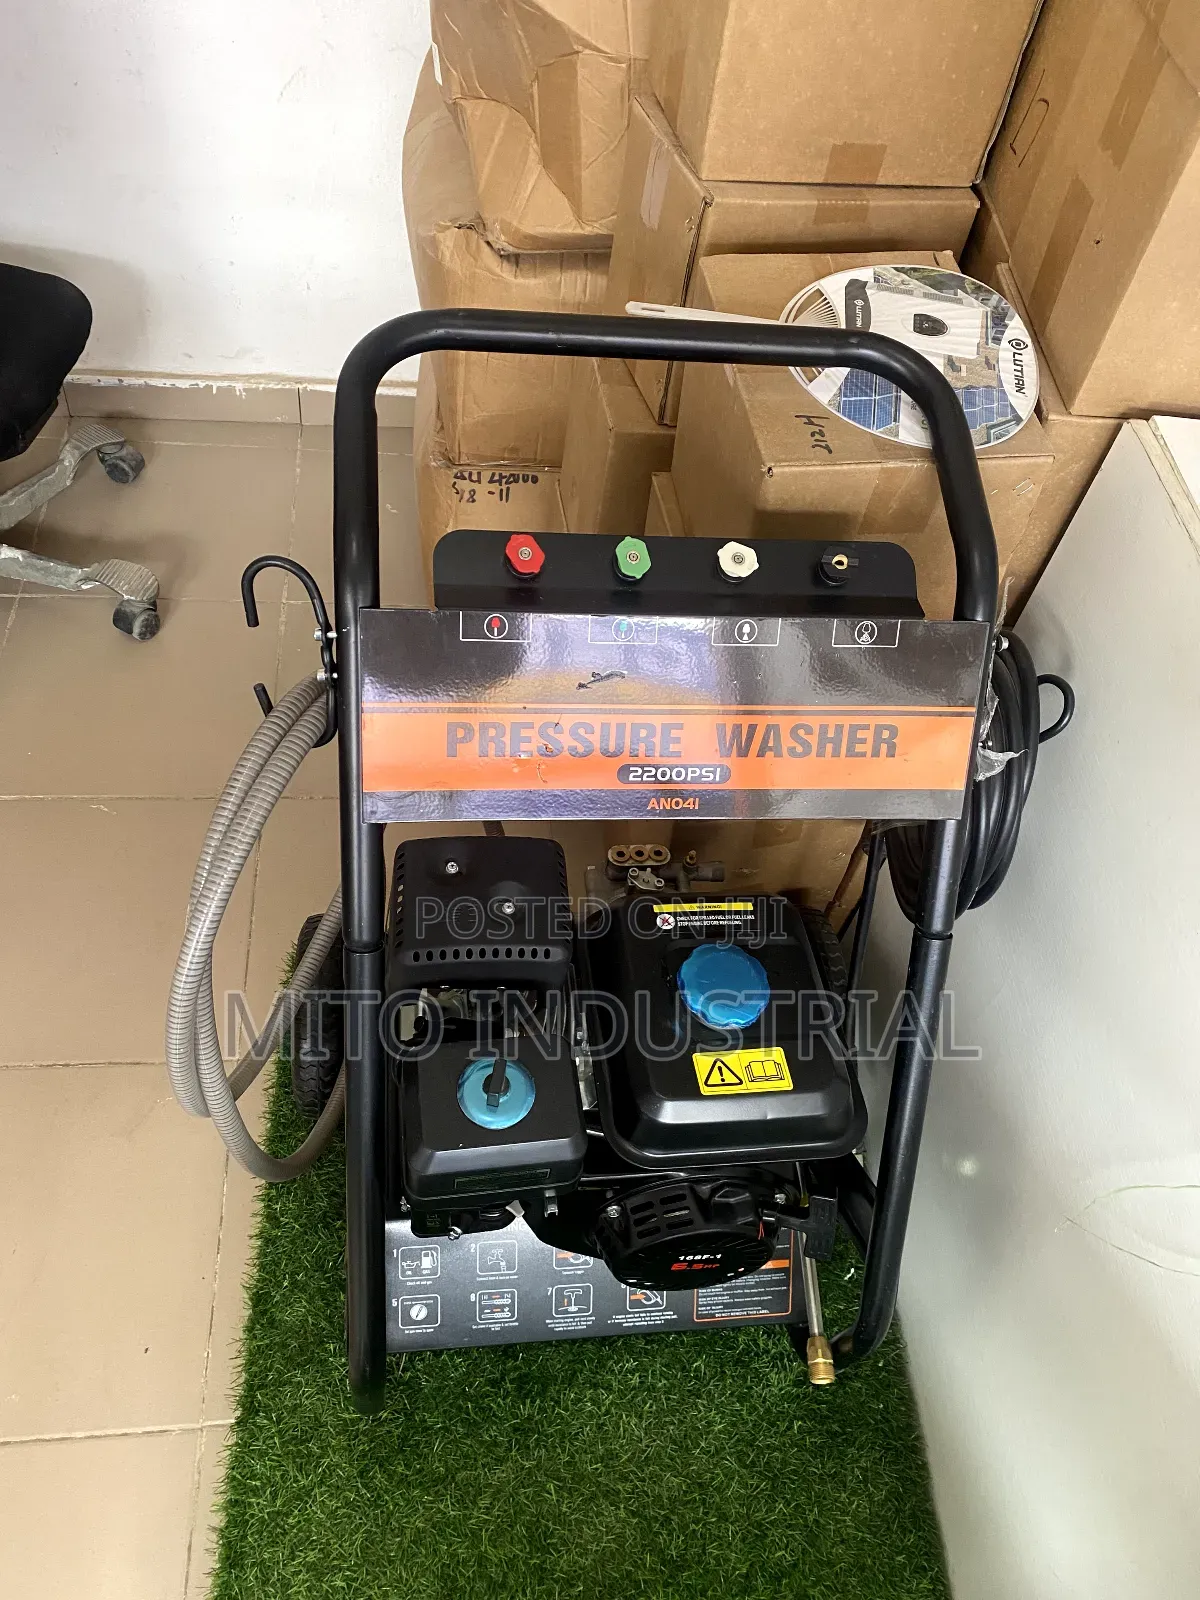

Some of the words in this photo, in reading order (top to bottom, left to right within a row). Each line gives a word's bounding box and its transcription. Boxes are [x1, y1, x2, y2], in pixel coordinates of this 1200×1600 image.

[1011, 350, 1026, 395] LUTIAN
[446, 721, 685, 758] PRESSURE
[715, 722, 899, 759] WASHER
[628, 766, 721, 782] 2200PSI
[547, 1287, 552, 1296] 7
[392, 1298, 398, 1307] 5
